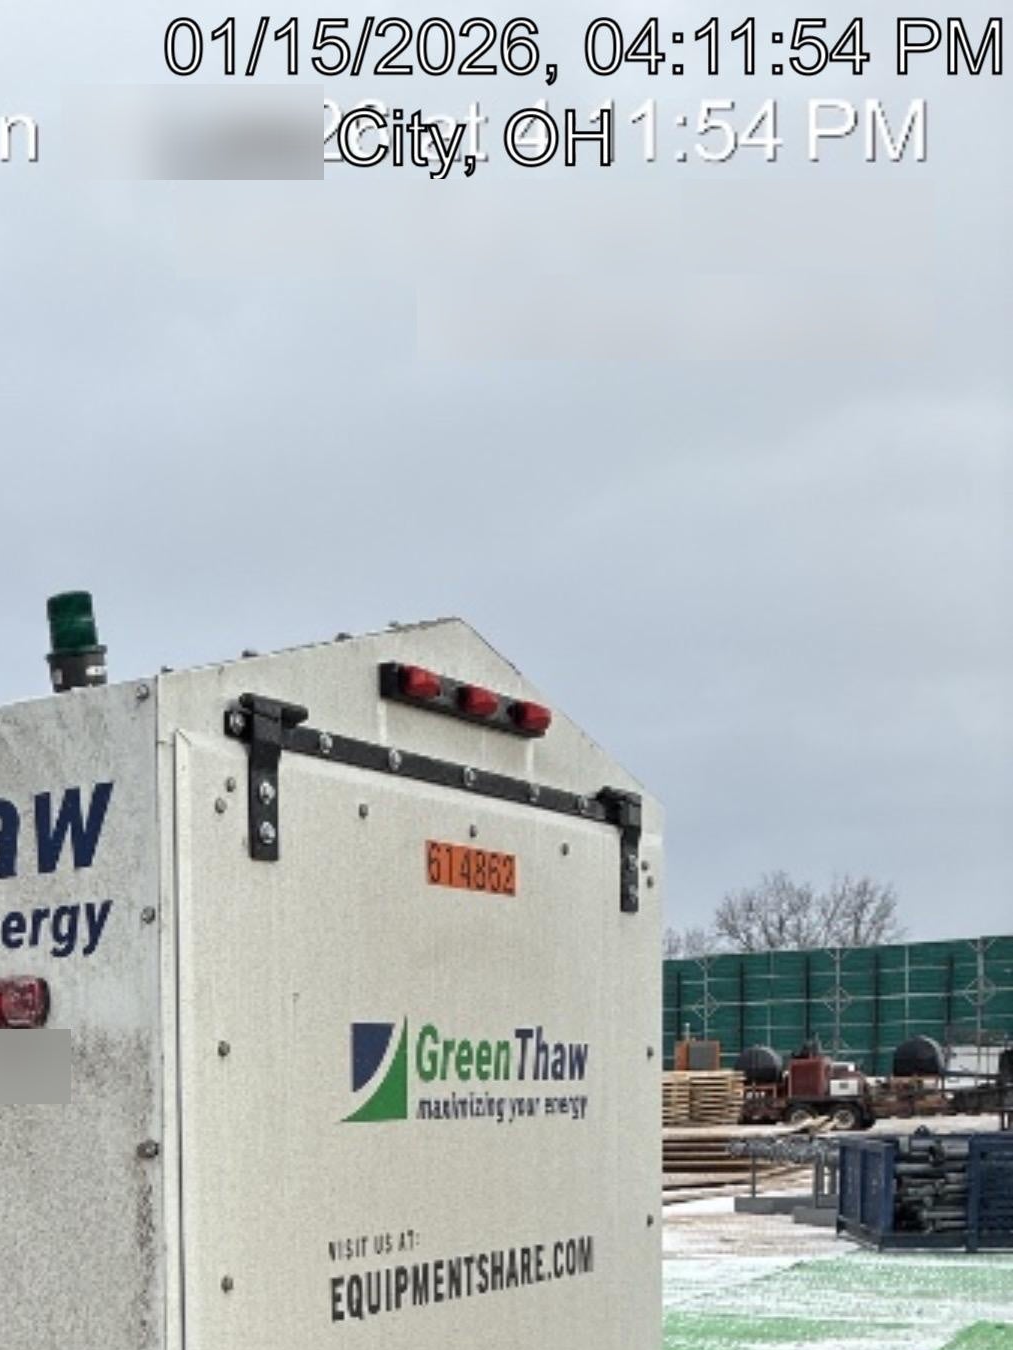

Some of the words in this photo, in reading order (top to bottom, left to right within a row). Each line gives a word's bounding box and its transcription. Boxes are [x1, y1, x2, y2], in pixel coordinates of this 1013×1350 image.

[426, 842, 516, 895] 614862
[417, 1091, 504, 1124] maximizing
[508, 1096, 539, 1124] your
[544, 1094, 588, 1120] energy
[328, 1236, 368, 1261] VISIT
[373, 1233, 393, 1255] US
[398, 1229, 420, 1251] AT:
[330, 1235, 594, 1322] EQUIPMENTSHARE.COM
